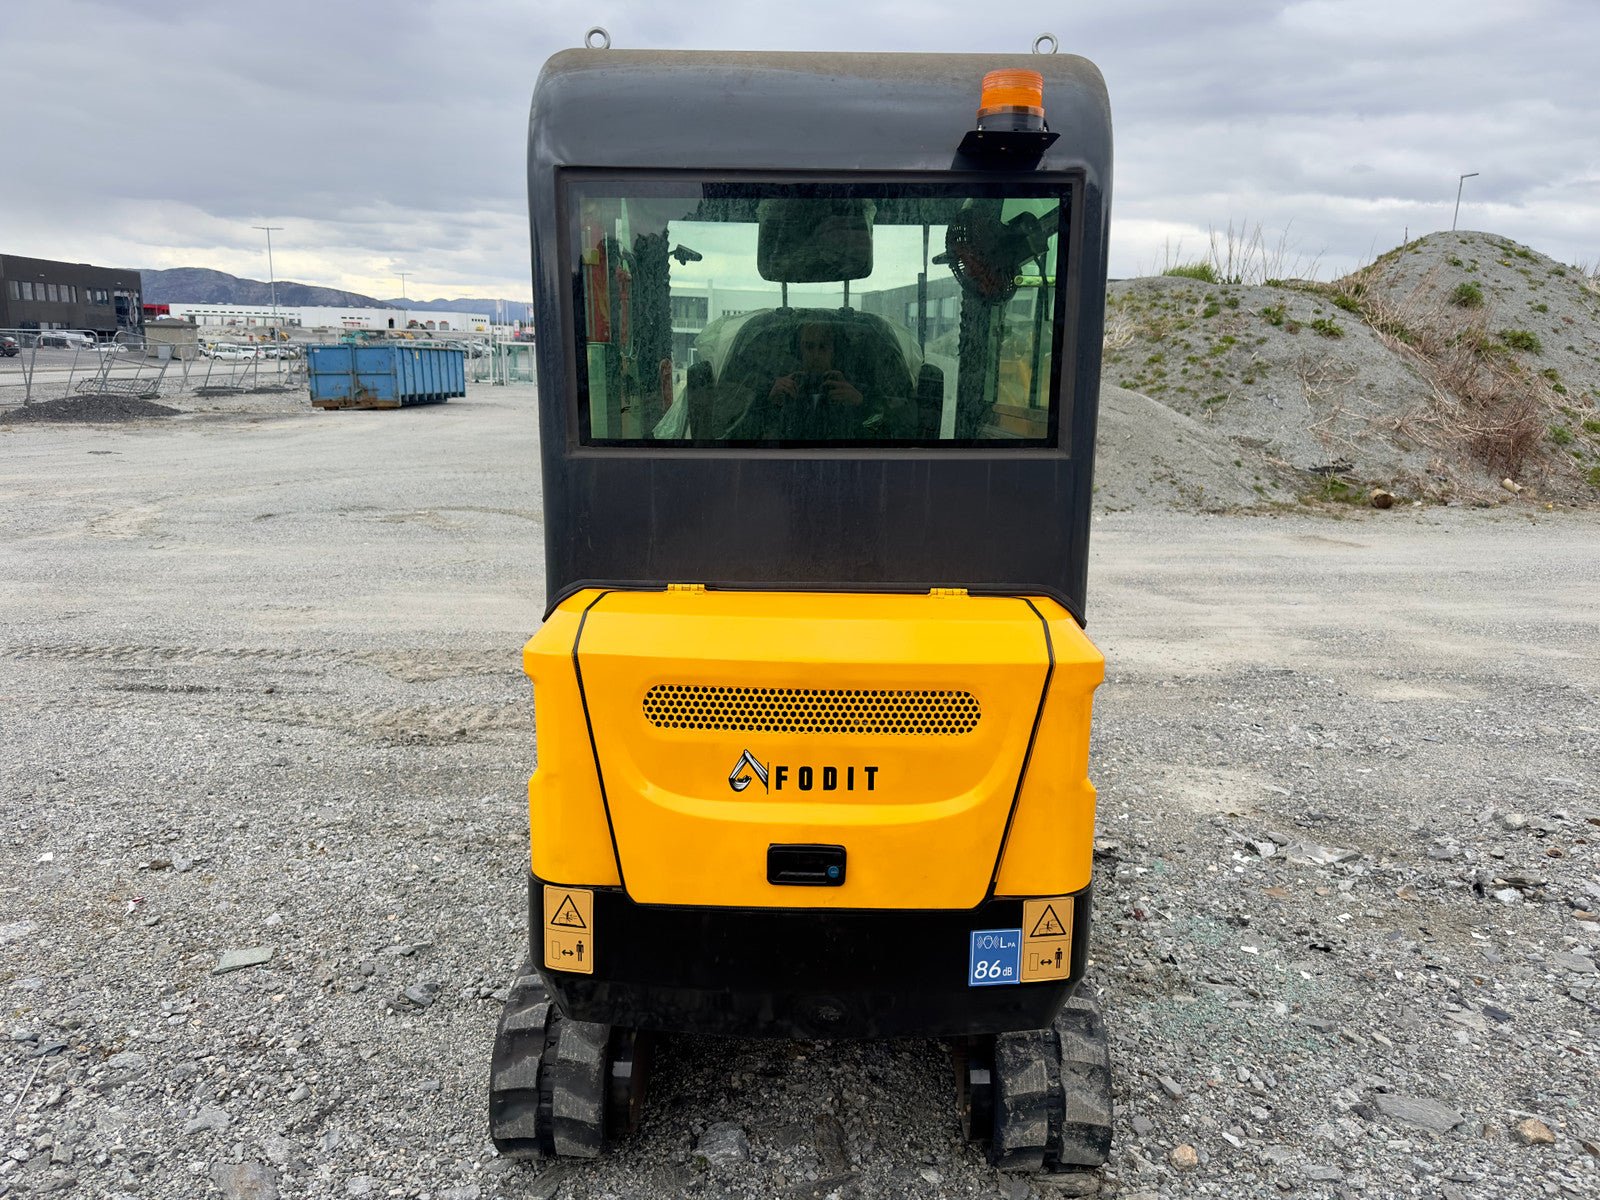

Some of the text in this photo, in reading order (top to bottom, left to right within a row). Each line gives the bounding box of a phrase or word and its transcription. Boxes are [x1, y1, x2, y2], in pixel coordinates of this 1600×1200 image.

[775, 765, 879, 791] FODIT
[974, 960, 1013, 979] 86 dB
